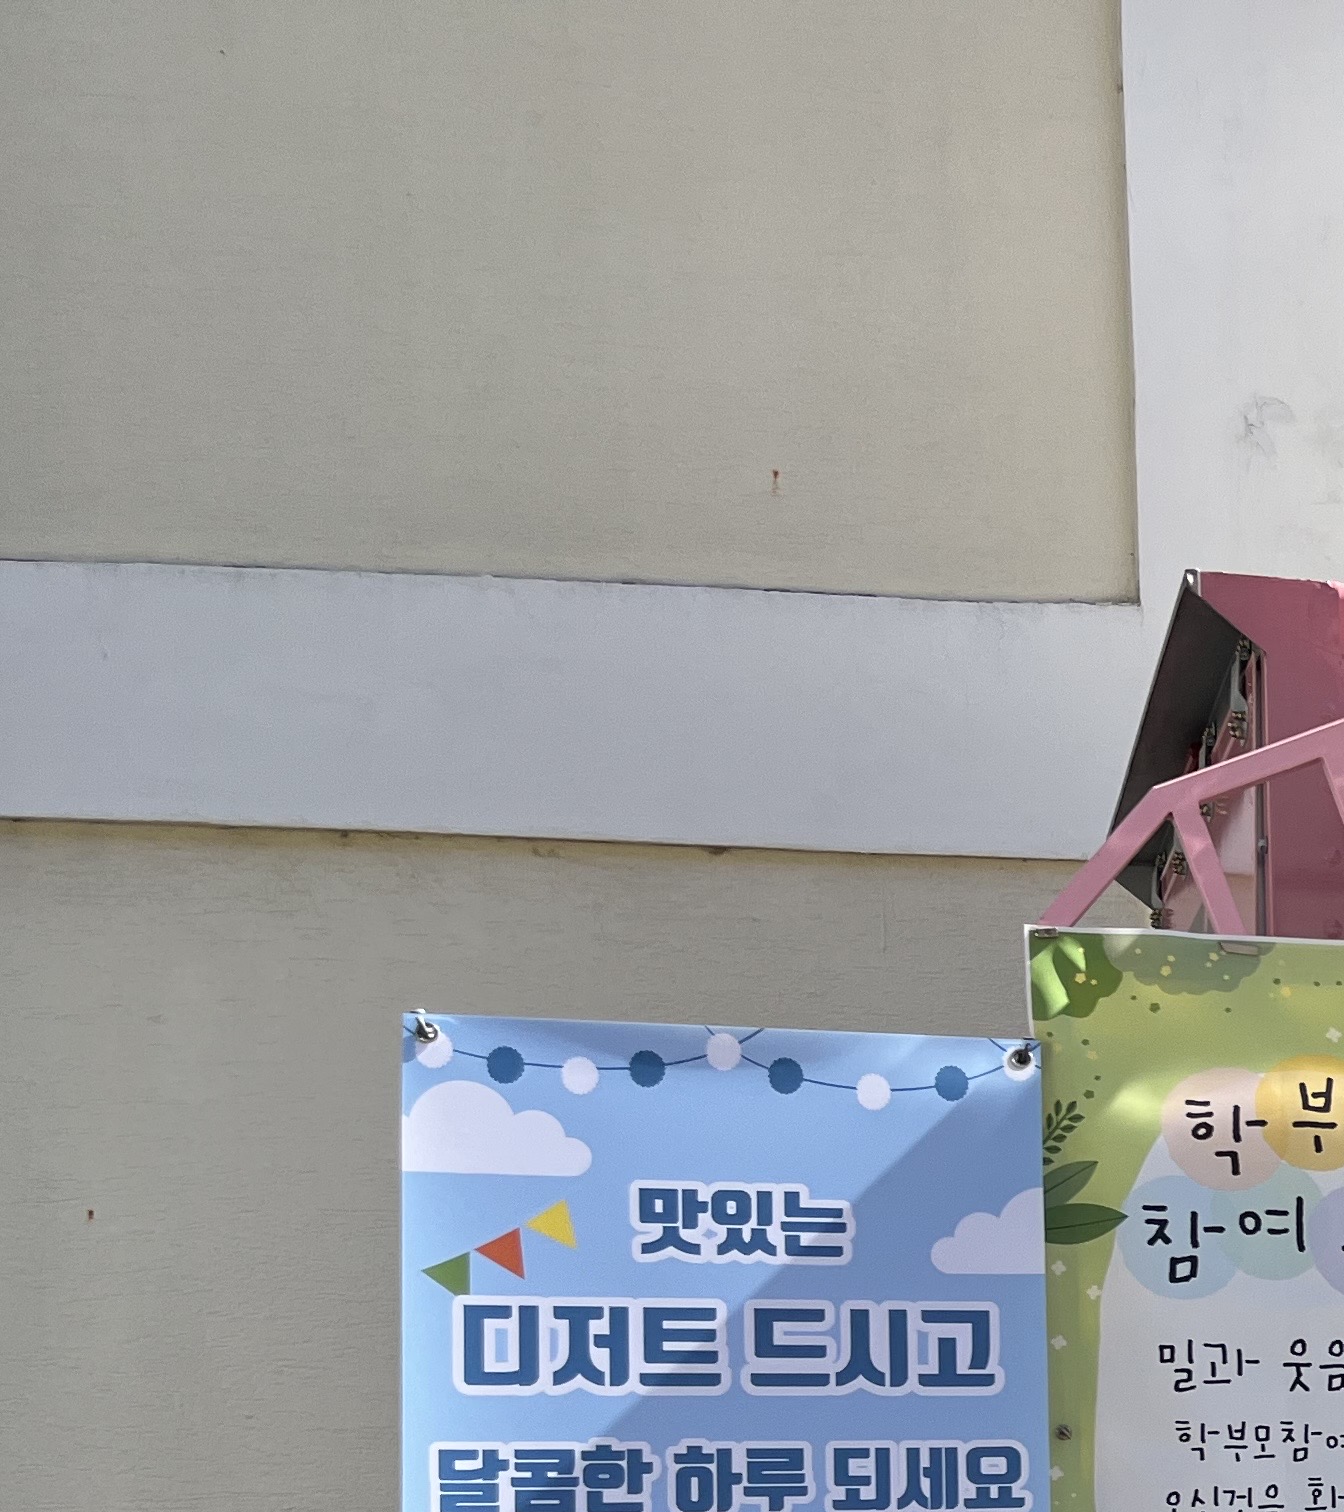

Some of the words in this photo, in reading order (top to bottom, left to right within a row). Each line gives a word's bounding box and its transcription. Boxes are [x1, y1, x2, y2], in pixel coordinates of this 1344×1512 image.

[633, 1184, 852, 1261] 맛있는
[459, 1300, 726, 1391] 디저트
[746, 1303, 1000, 1391] 드시고
